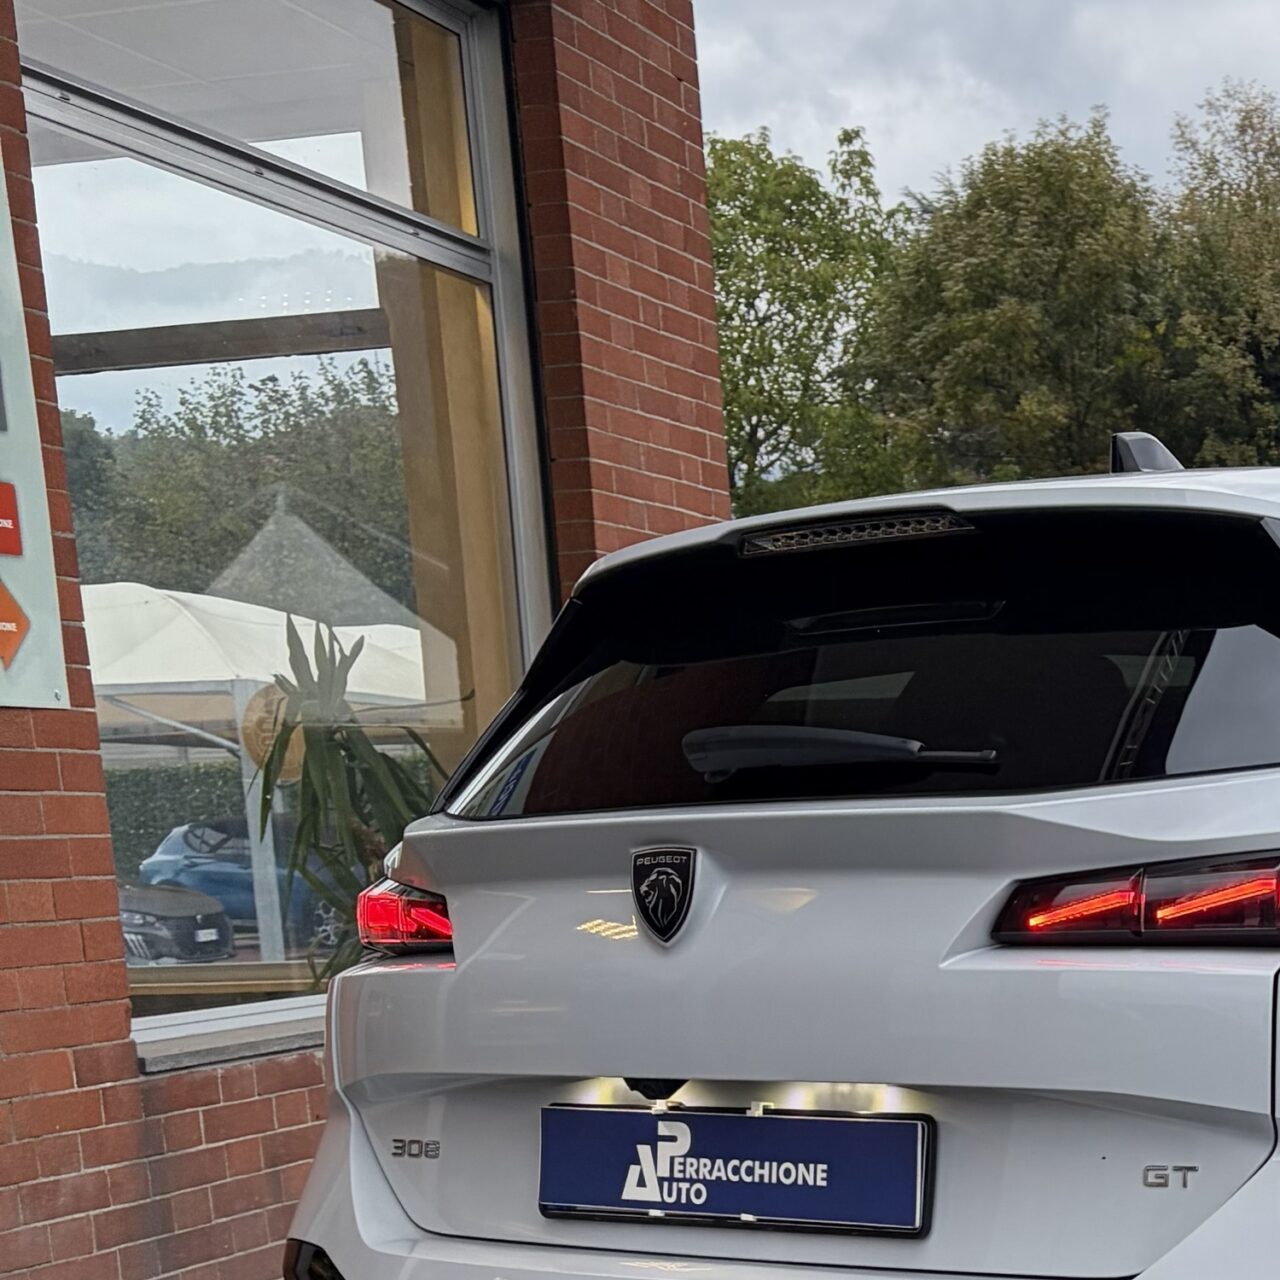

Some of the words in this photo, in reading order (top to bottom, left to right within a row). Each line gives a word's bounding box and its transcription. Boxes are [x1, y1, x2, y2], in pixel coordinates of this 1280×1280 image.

[636, 855, 688, 866] PEUGEOT
[391, 1138, 441, 1159] 308
[656, 1120, 828, 1187] PERRACCHIONE
[621, 1144, 708, 1205] AUTO
[1142, 1164, 1200, 1189] GT
